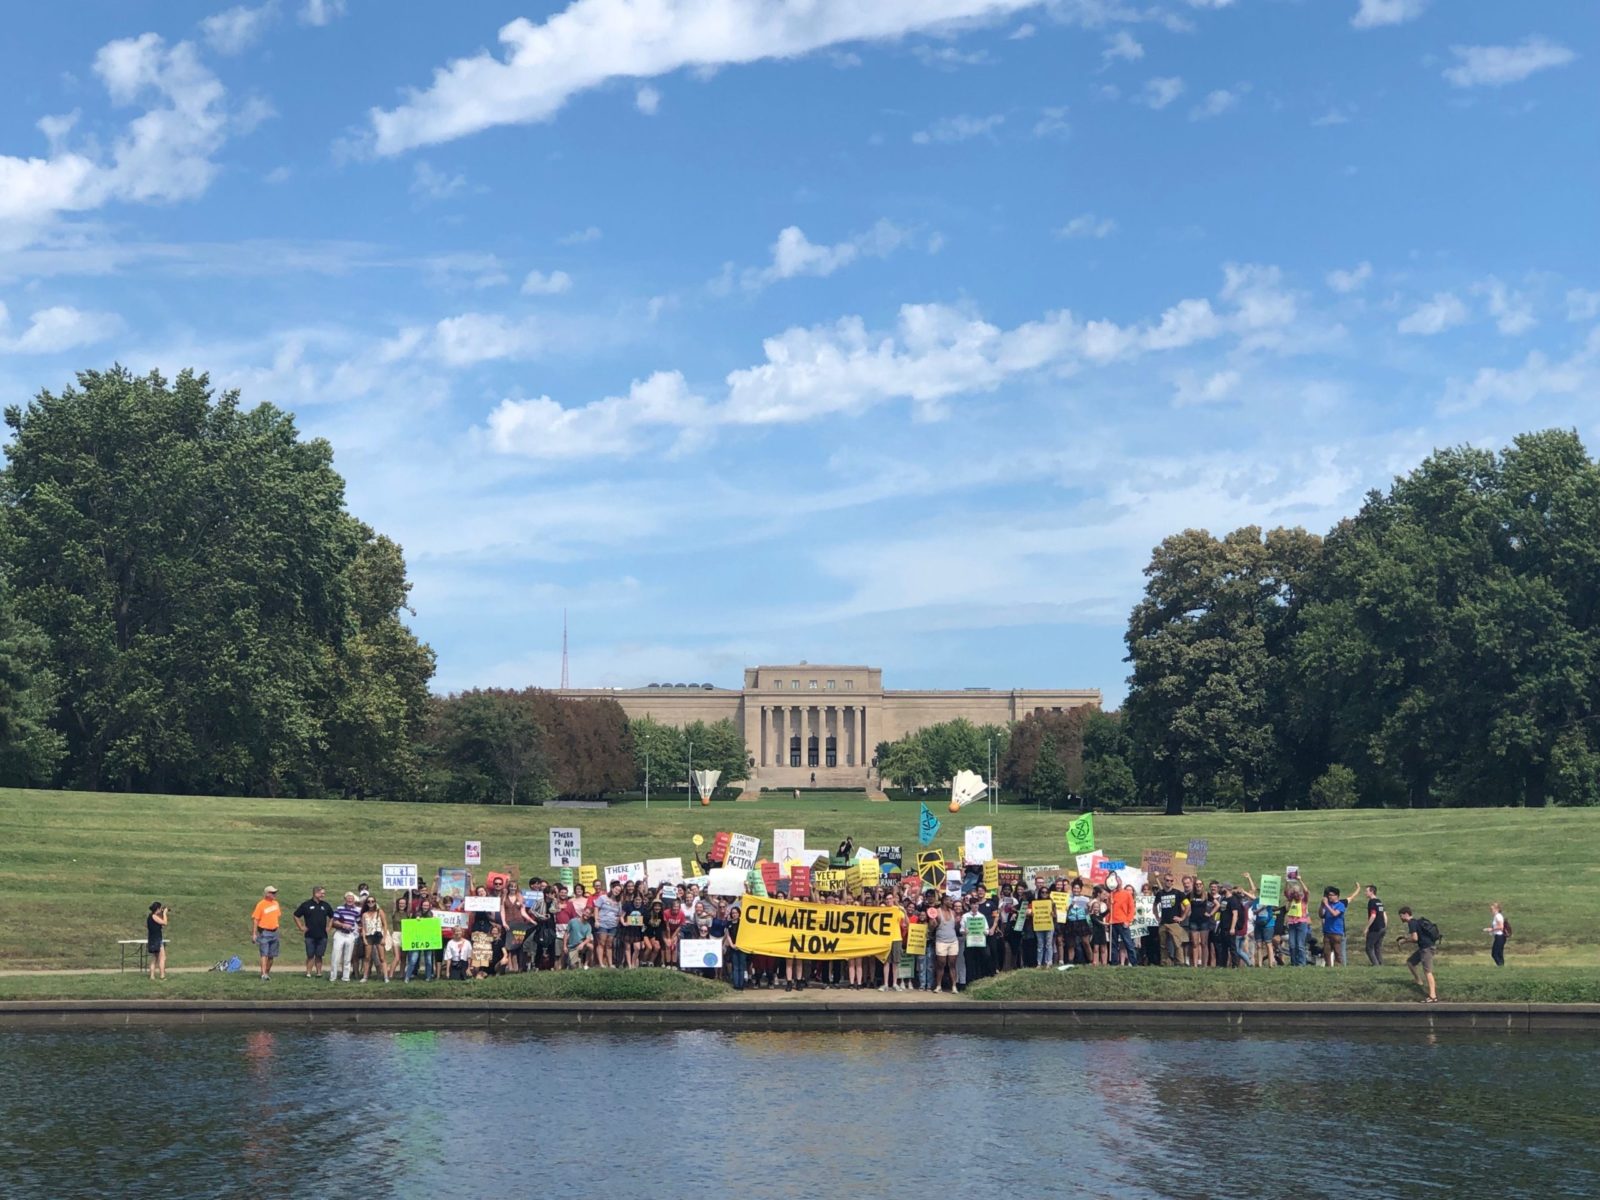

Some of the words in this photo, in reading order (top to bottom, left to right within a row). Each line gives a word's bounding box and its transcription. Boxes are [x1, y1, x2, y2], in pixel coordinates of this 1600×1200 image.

[554, 848, 580, 857] PLANET
[730, 846, 753, 857] CLIMATE
[727, 856, 755, 870] ACTION
[606, 866, 630, 875] THERE
[816, 871, 837, 880] YEET
[386, 877, 408, 886] PLANET
[745, 905, 817, 932] CLIMATE
[819, 910, 893, 937] JUSTICE
[411, 941, 430, 949] DEAD
[789, 933, 840, 955] NOW
